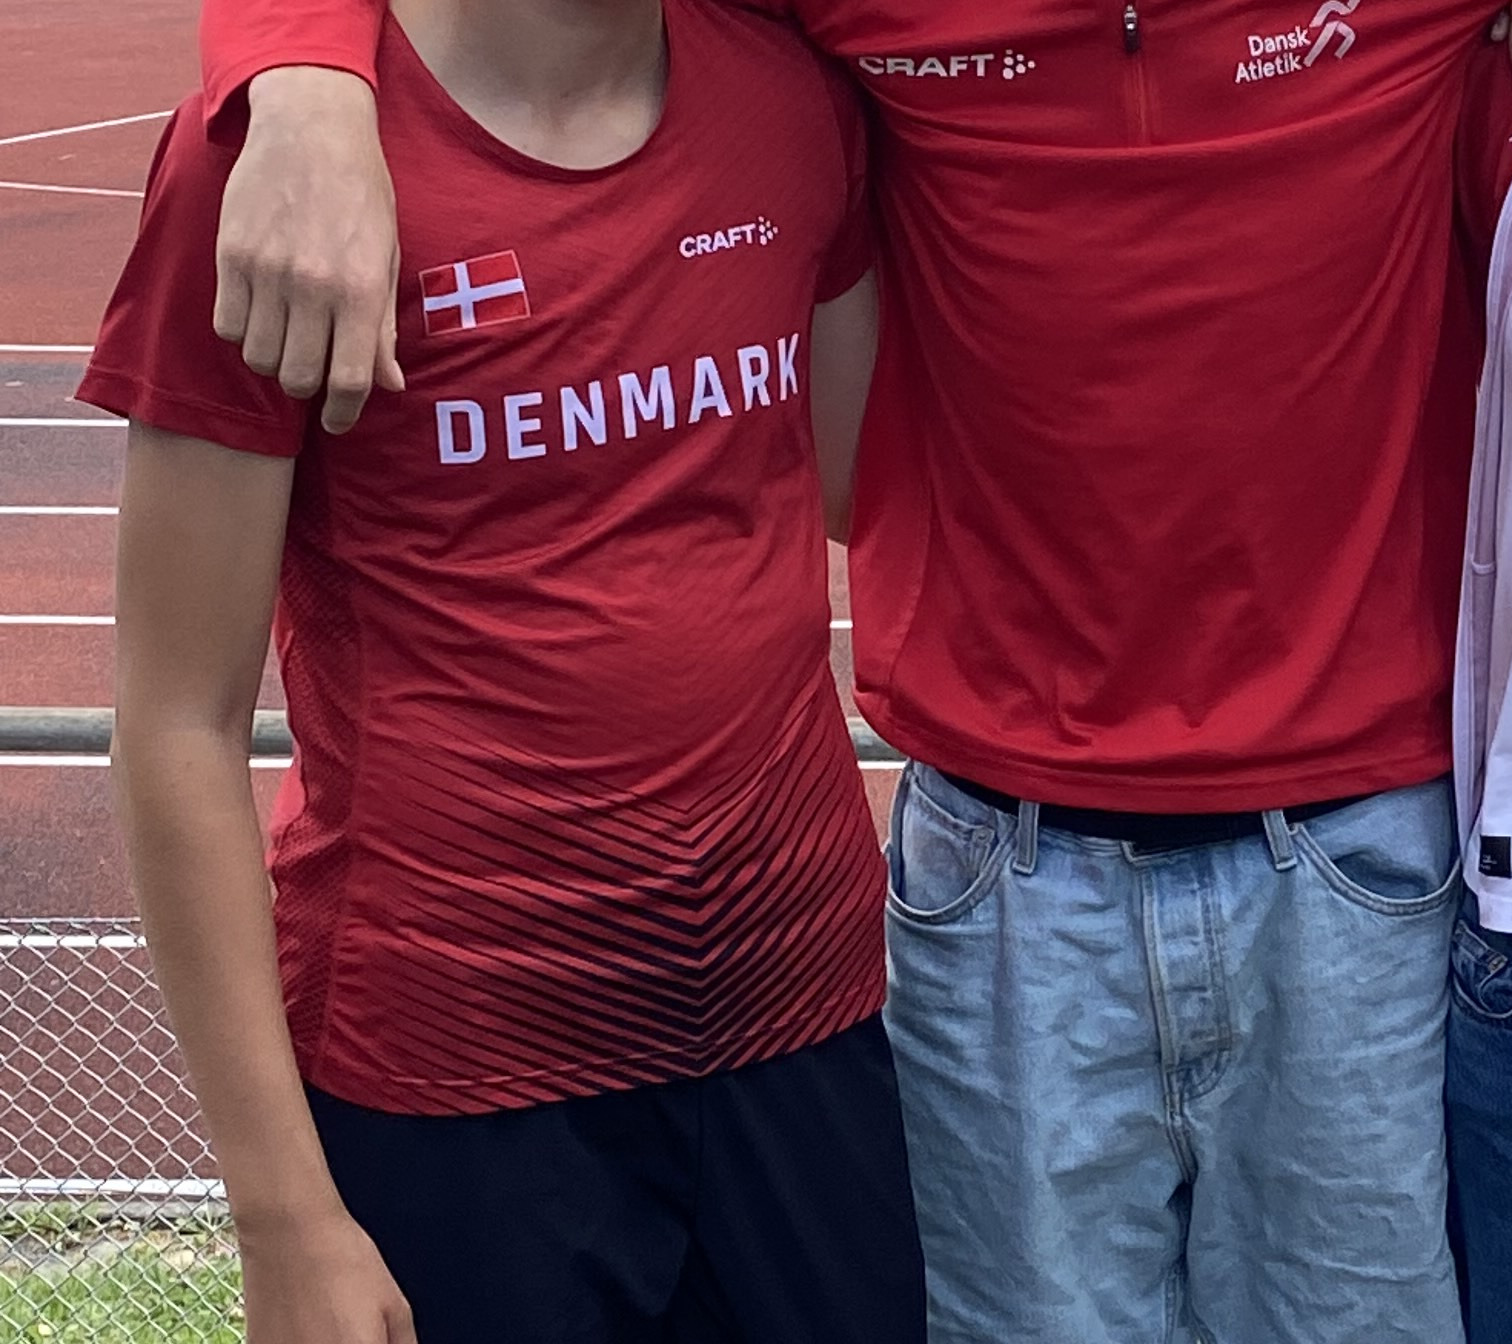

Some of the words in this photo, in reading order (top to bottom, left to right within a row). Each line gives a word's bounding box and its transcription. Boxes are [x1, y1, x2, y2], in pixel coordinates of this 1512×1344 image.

[1247, 25, 1312, 56] Dansk
[858, 53, 995, 78] CRAFT
[1234, 51, 1303, 84] Atletik
[679, 222, 757, 259] CRAFT
[435, 332, 800, 465] DENMARK
